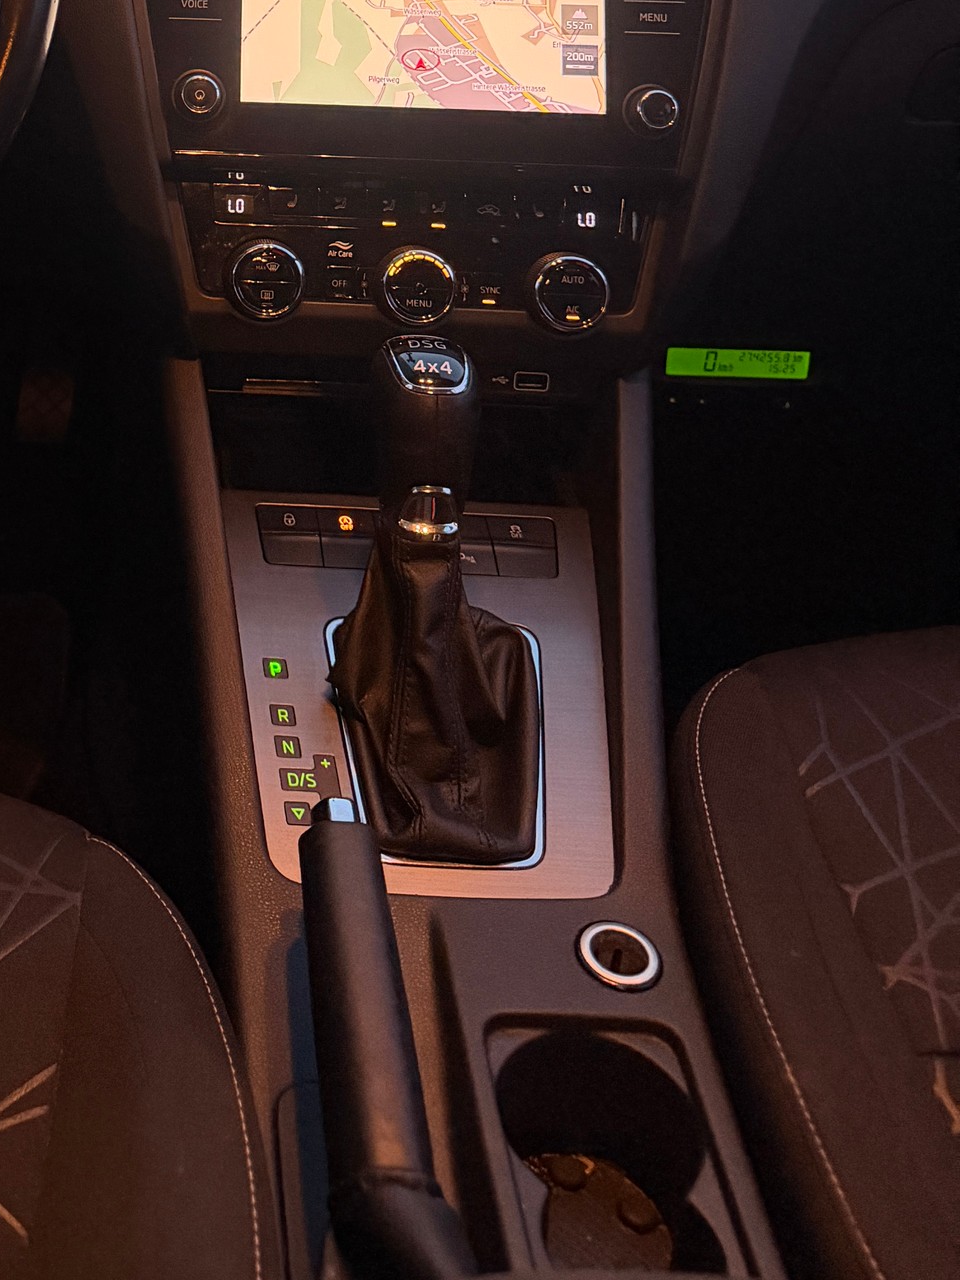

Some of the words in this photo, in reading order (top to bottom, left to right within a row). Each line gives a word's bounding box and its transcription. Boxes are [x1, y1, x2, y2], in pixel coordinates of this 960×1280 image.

[181, 0, 208, 9] VOICE
[639, 13, 668, 23] MENU
[566, 21, 593, 30] 552m
[566, 52, 594, 62] 200m
[368, 76, 400, 85] Pilgerweg
[227, 198, 245, 213] LO
[327, 250, 337, 258] Air
[338, 250, 353, 258] Care
[331, 279, 347, 288] OFF
[561, 276, 584, 284] AUTO
[480, 286, 501, 295] SYNC
[406, 299, 432, 308] MENU
[566, 306, 579, 314] A/C
[408, 339, 447, 350] DSG
[413, 359, 453, 375] 4x4
[269, 661, 282, 677] P
[277, 709, 289, 723] R
[282, 740, 295, 754] N
[287, 772, 317, 788] D/S
